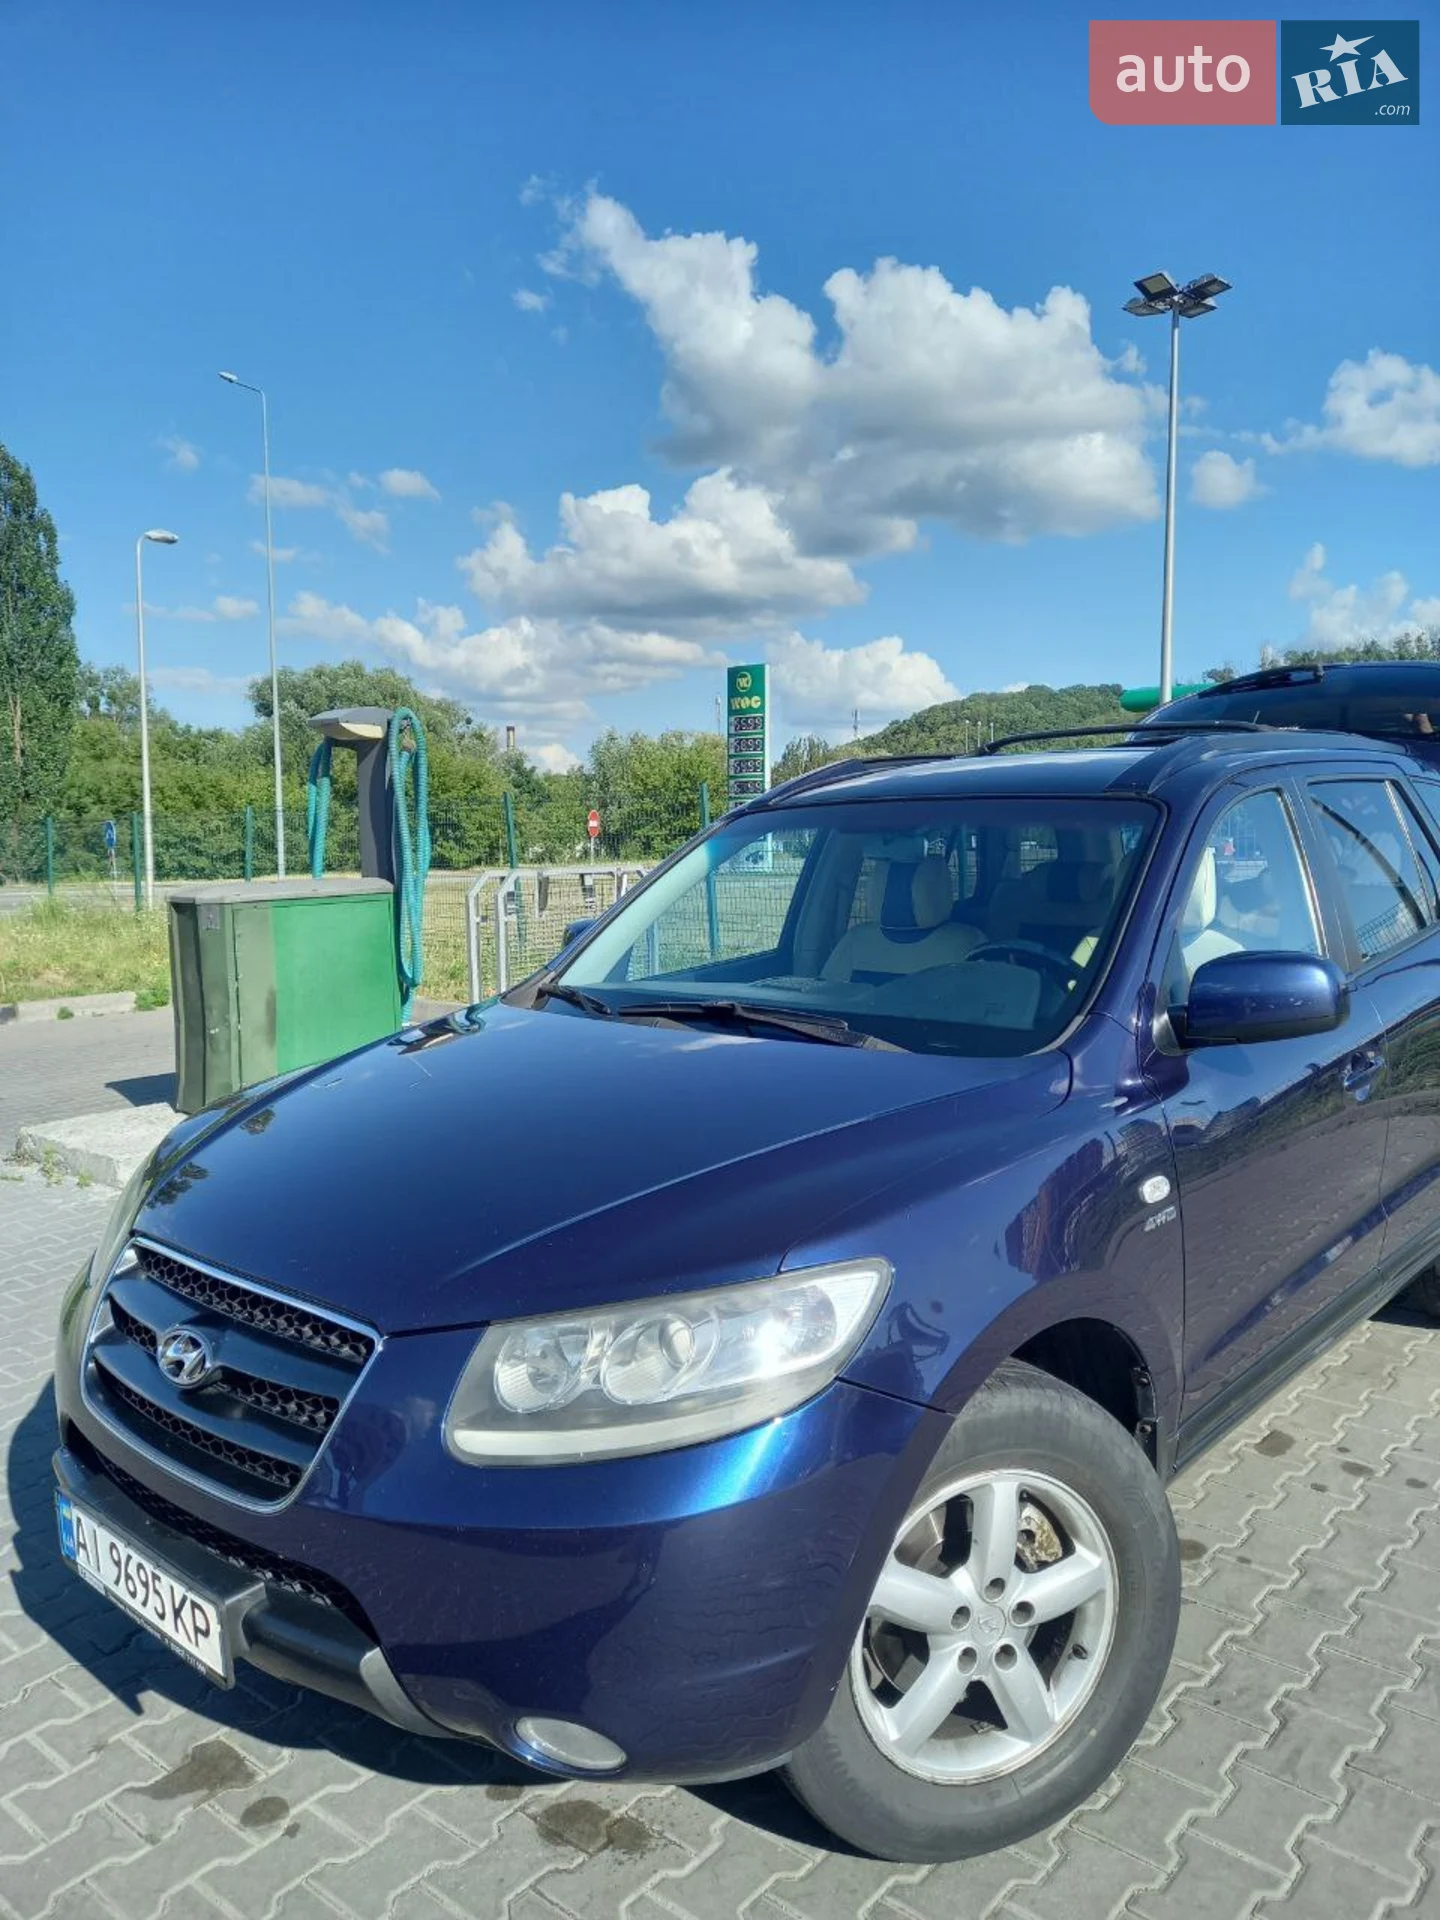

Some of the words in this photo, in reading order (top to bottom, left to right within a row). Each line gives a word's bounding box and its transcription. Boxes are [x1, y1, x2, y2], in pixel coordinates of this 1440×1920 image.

[76, 1517, 101, 1572] AI
[109, 1541, 166, 1621] 9695
[170, 1585, 211, 1649] KP
